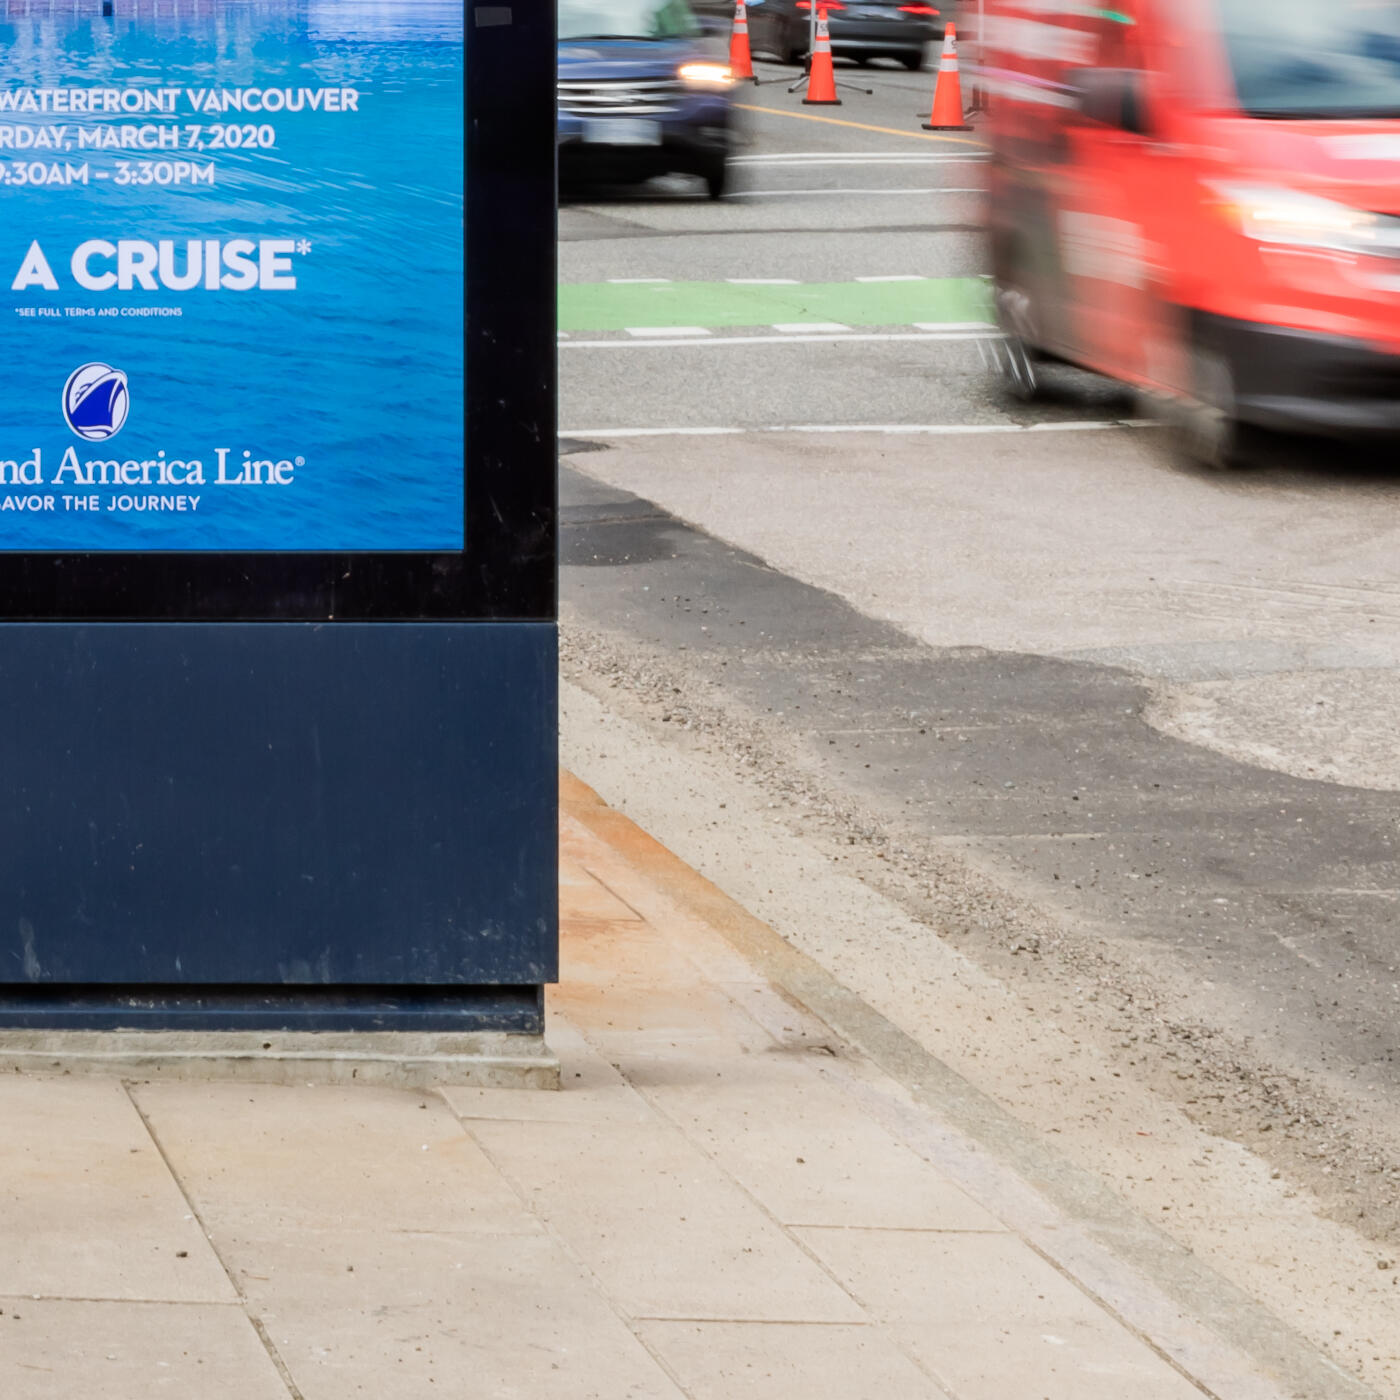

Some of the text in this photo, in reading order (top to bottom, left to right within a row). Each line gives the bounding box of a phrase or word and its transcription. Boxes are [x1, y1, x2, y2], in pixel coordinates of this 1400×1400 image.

[186, 87, 359, 112] VANCOUVER
[78, 125, 179, 149] MARCH
[185, 125, 204, 151] 7,
[208, 124, 275, 148] 2020
[113, 161, 215, 185] 3:30PM
[11, 240, 59, 290] A
[38, 307, 61, 317] FULL
[65, 307, 96, 317] TERMS
[98, 307, 119, 317] AND
[120, 307, 183, 317] CONDITIONS
[51, 446, 206, 485] America
[62, 495, 100, 511] THE
[107, 495, 200, 511] JOURNEY
